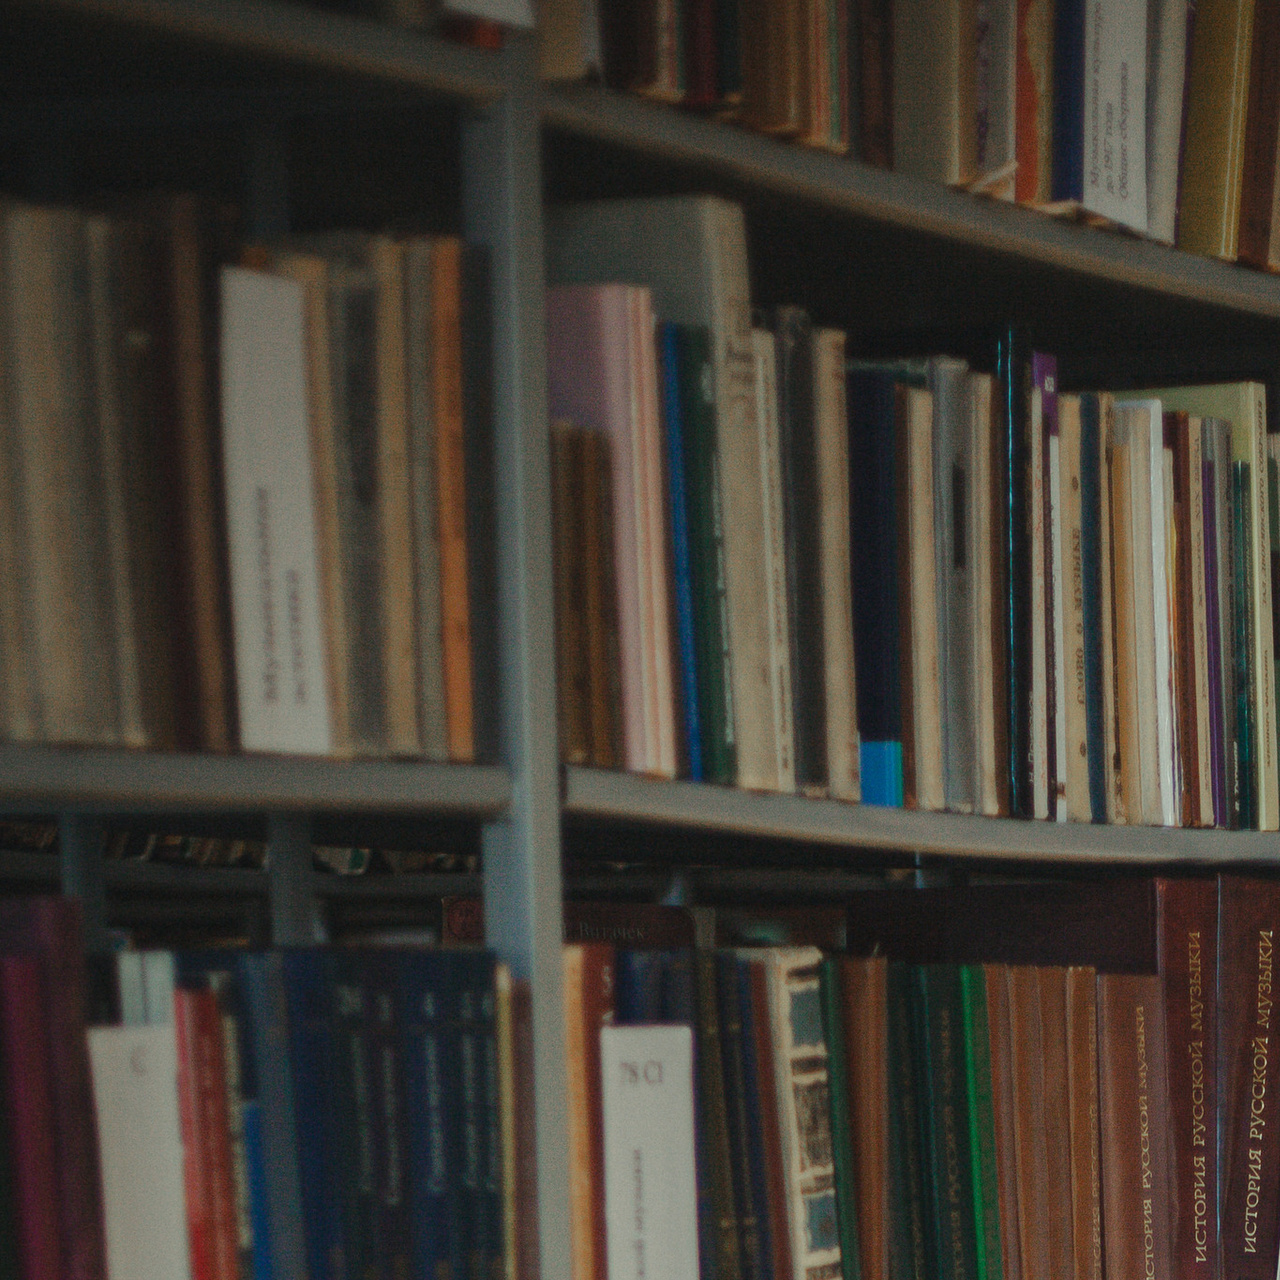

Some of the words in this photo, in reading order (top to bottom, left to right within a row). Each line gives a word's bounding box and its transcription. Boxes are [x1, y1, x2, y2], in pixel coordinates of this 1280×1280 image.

[1187, 930, 1205, 1031] МУЗЫКИ
[1254, 929, 1274, 1030] МУЗЫКИ
[1134, 1005, 1149, 1090] МУЗЫКИ
[1187, 1039, 1206, 1147] РУССКОЙ
[1249, 1036, 1269, 1140] РУССКОЙ
[1137, 1095, 1153, 1190] РУССКОЙ
[1192, 1155, 1209, 1263] ИСТОРИЯ
[1243, 1148, 1263, 1254] ИСТОРИЯ
